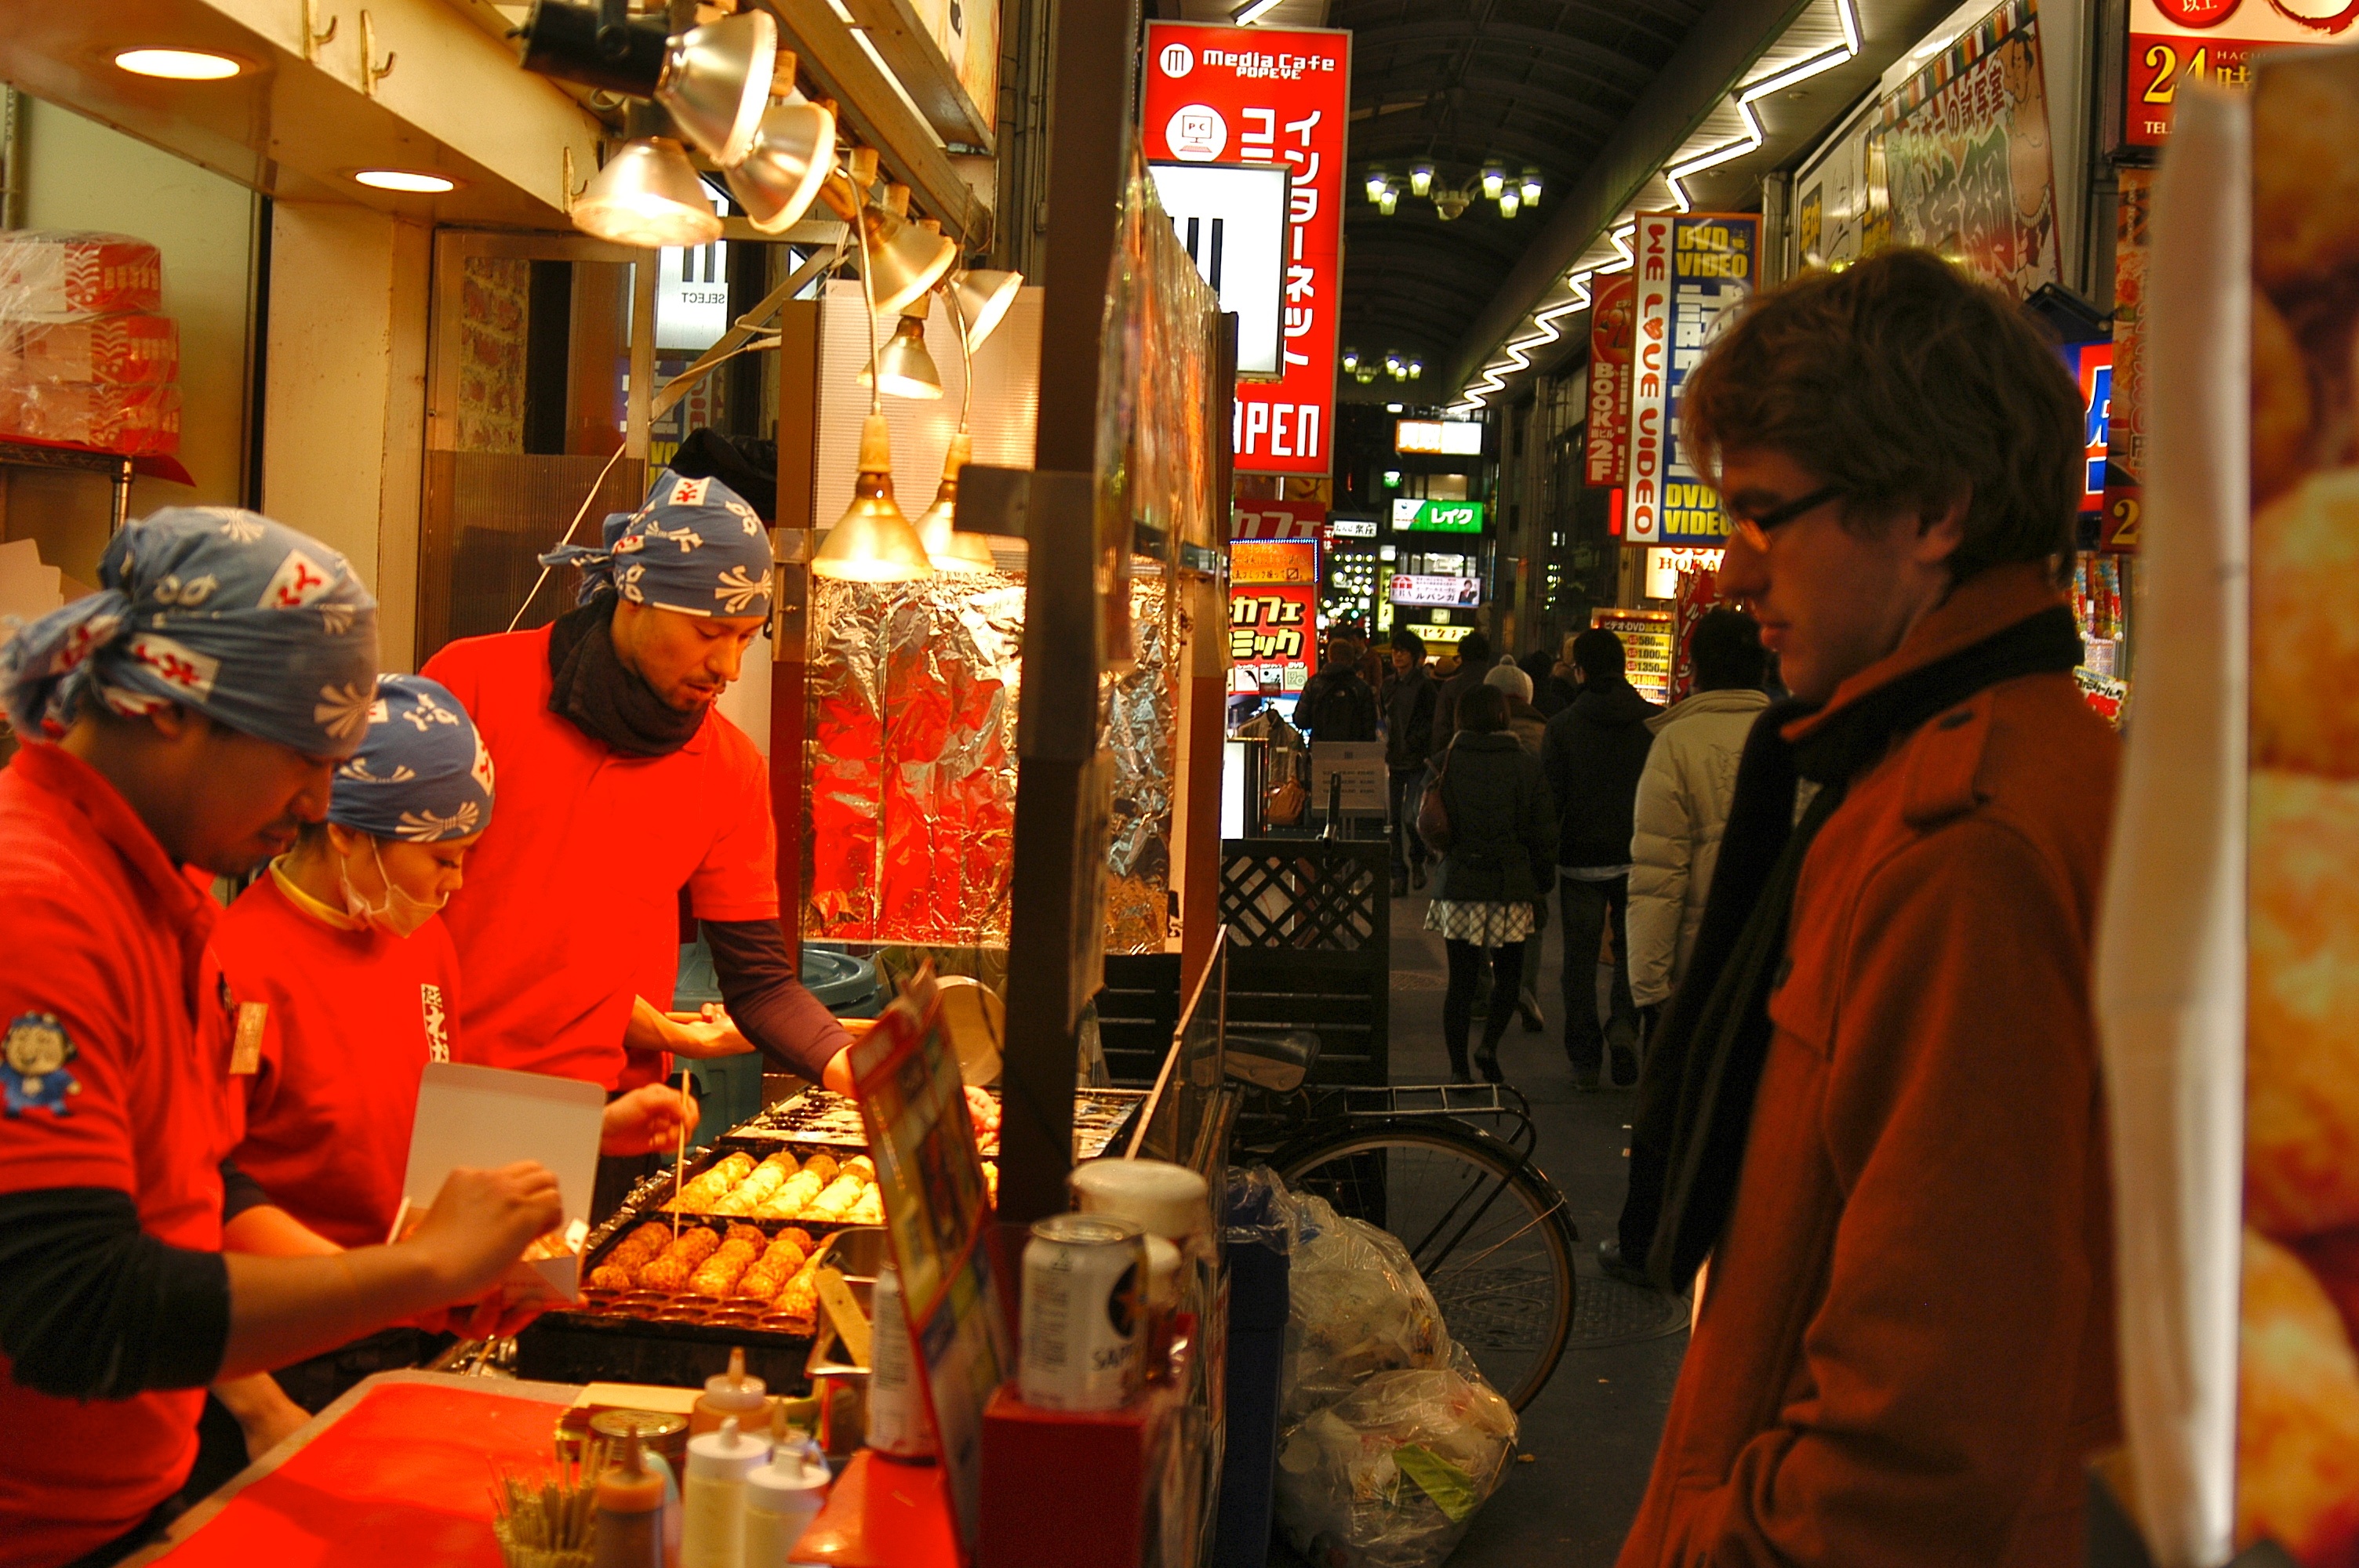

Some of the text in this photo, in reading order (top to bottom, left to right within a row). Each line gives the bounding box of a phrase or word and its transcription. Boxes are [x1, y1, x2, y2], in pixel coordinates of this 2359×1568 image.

[1203, 49, 1335, 71] Media Cafe
[1236, 66, 1302, 80] POPEYE
[1677, 225, 1729, 250] DVD
[1676, 252, 1748, 278] VIDEO
[1430, 507, 1474, 525] レイク
[1229, 596, 1302, 623] カフェ
[1228, 629, 1301, 657] ミック
